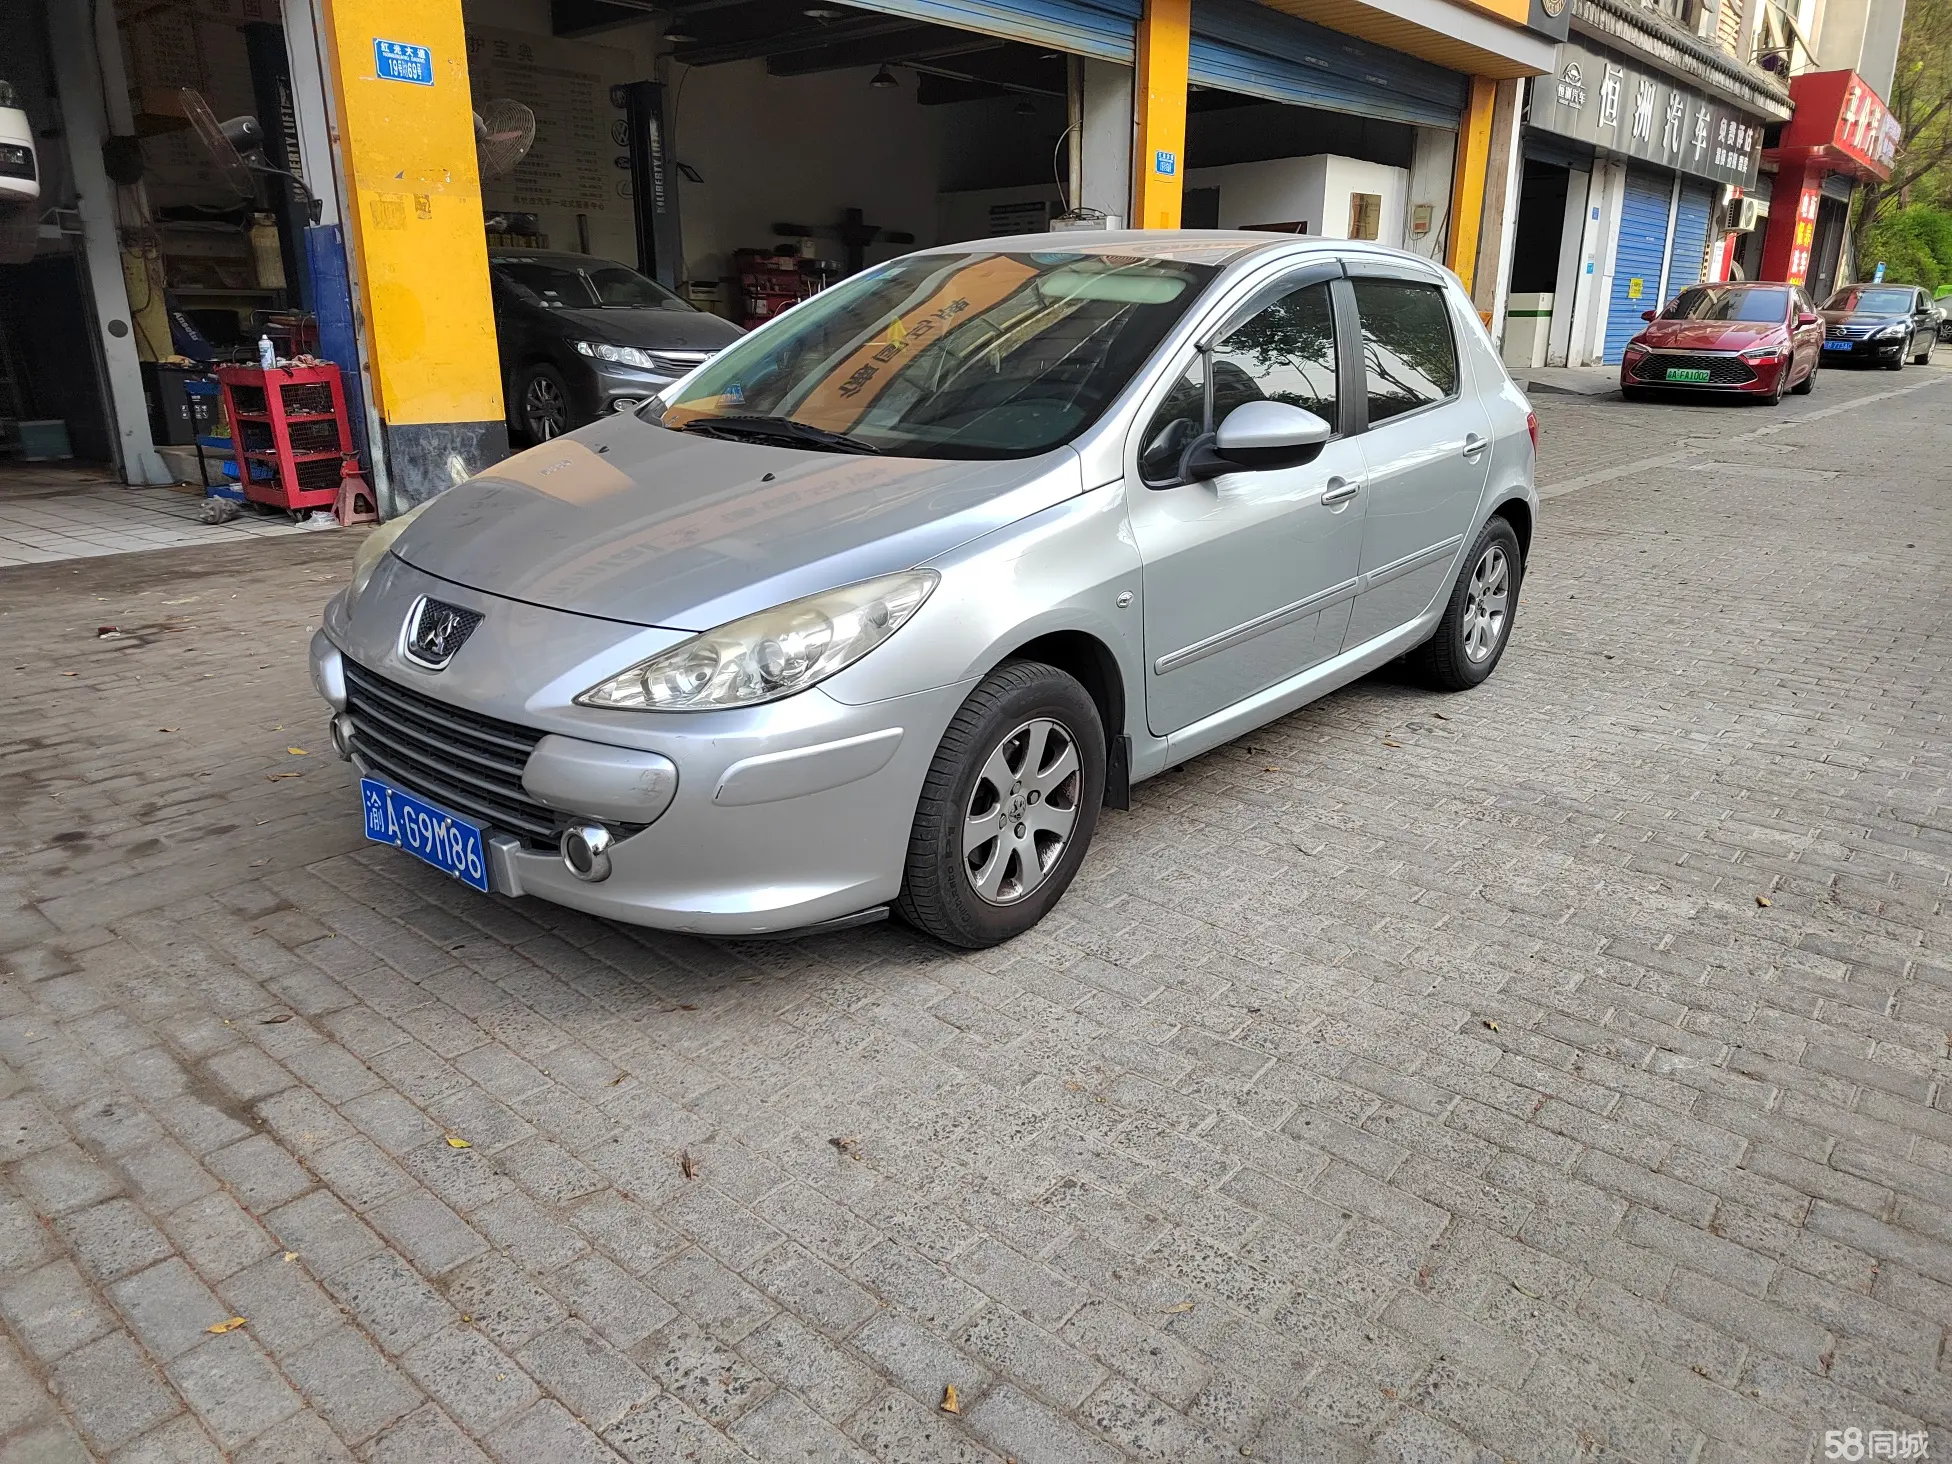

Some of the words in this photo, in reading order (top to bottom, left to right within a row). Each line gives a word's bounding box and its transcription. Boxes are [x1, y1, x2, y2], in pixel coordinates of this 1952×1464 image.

[380, 41, 426, 59] 红光大道
[1557, 83, 1586, 105] 恒洲汽车
[1597, 62, 1710, 161] 恒洲汽车
